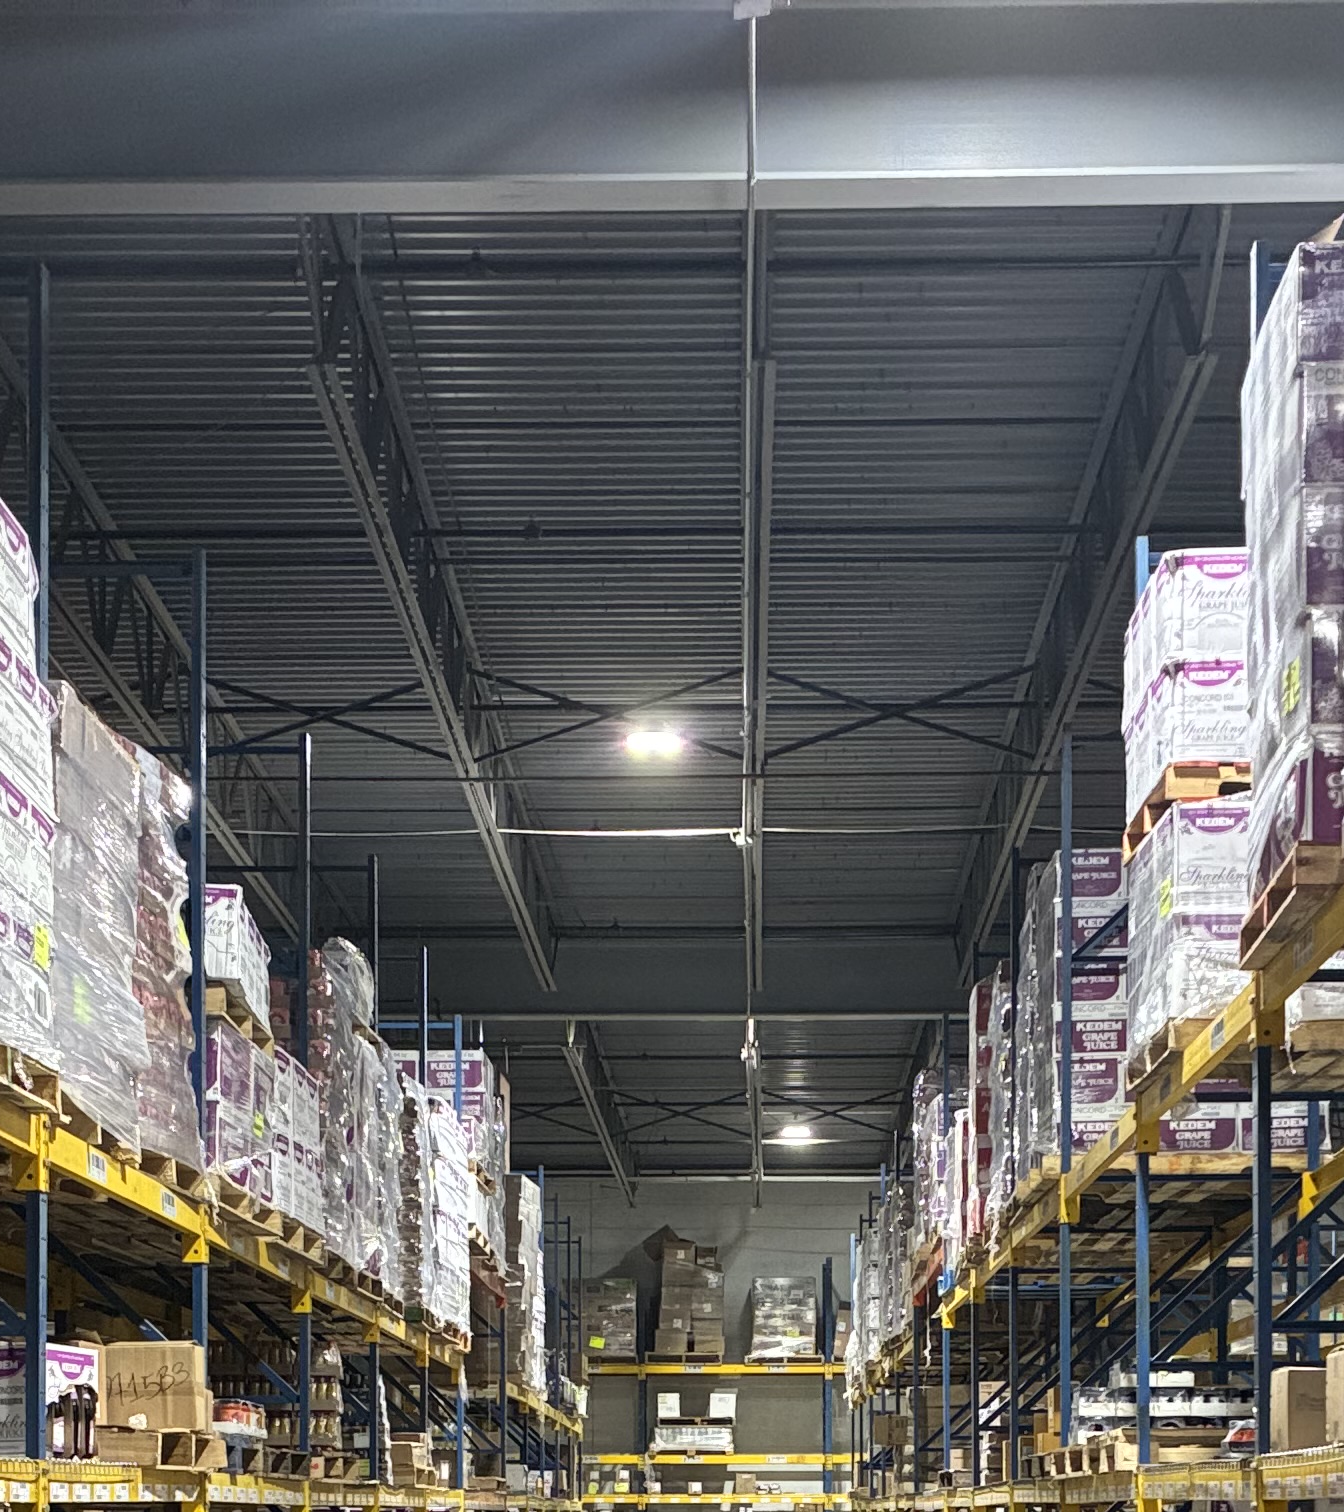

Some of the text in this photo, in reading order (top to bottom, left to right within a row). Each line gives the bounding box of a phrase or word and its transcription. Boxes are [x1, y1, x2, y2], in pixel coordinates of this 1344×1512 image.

[1179, 866, 1249, 885] Sparklin
[1076, 1021, 1122, 1031] KEDEM
[1082, 1032, 1118, 1041] GRAPE
[1083, 1041, 1118, 1051] JUICE
[1169, 1121, 1216, 1131] KEDEM
[1271, 1118, 1308, 1127] EDEM
[1175, 1131, 1211, 1140] GRAPE
[1177, 1140, 1211, 1149] JUICE
